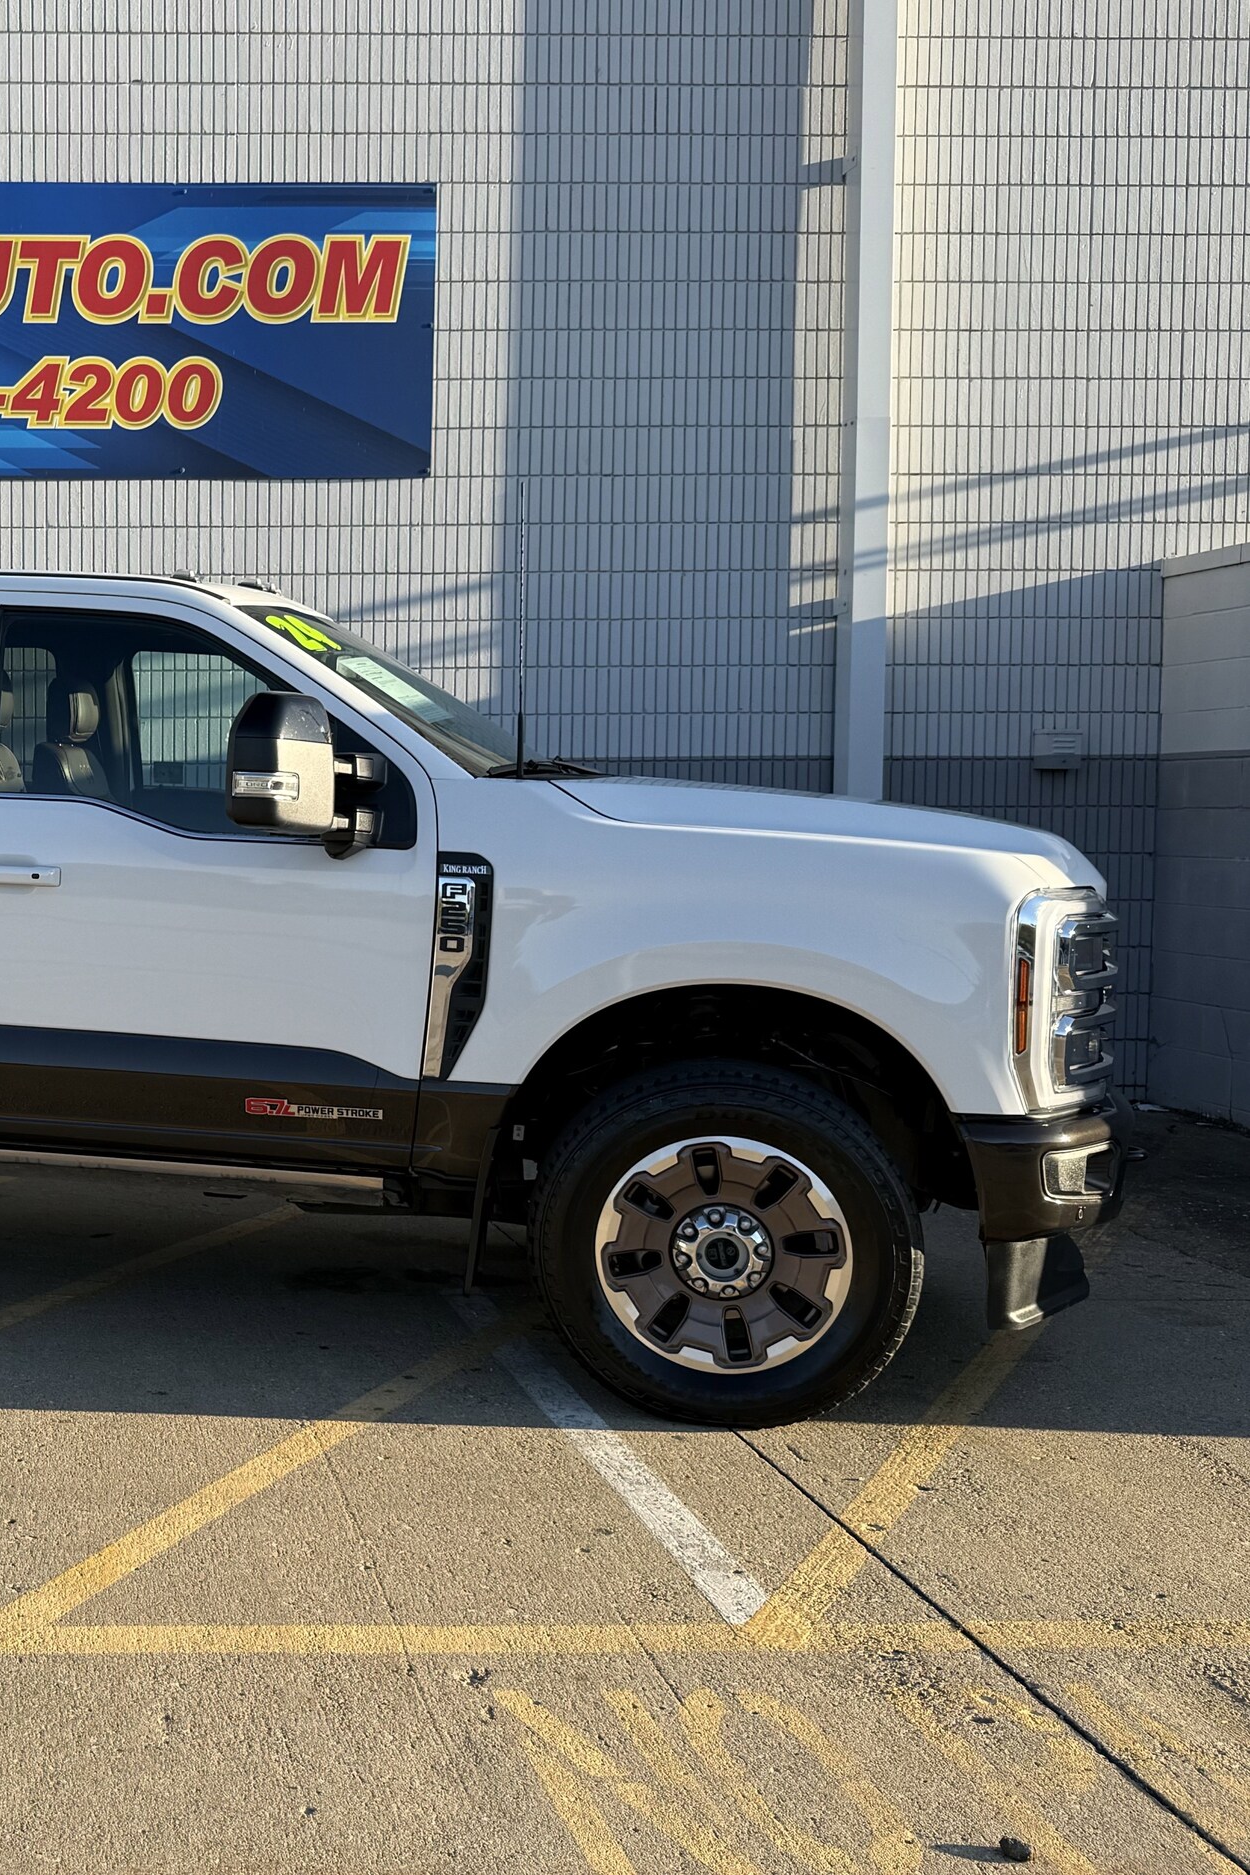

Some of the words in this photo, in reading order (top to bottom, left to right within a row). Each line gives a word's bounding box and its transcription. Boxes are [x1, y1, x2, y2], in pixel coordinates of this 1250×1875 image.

[443, 863, 462, 874] KING
[462, 864, 487, 875] RANCH
[245, 1097, 296, 1116] 6.7L
[297, 1105, 334, 1116] POWER
[337, 1107, 380, 1118] STROKE
